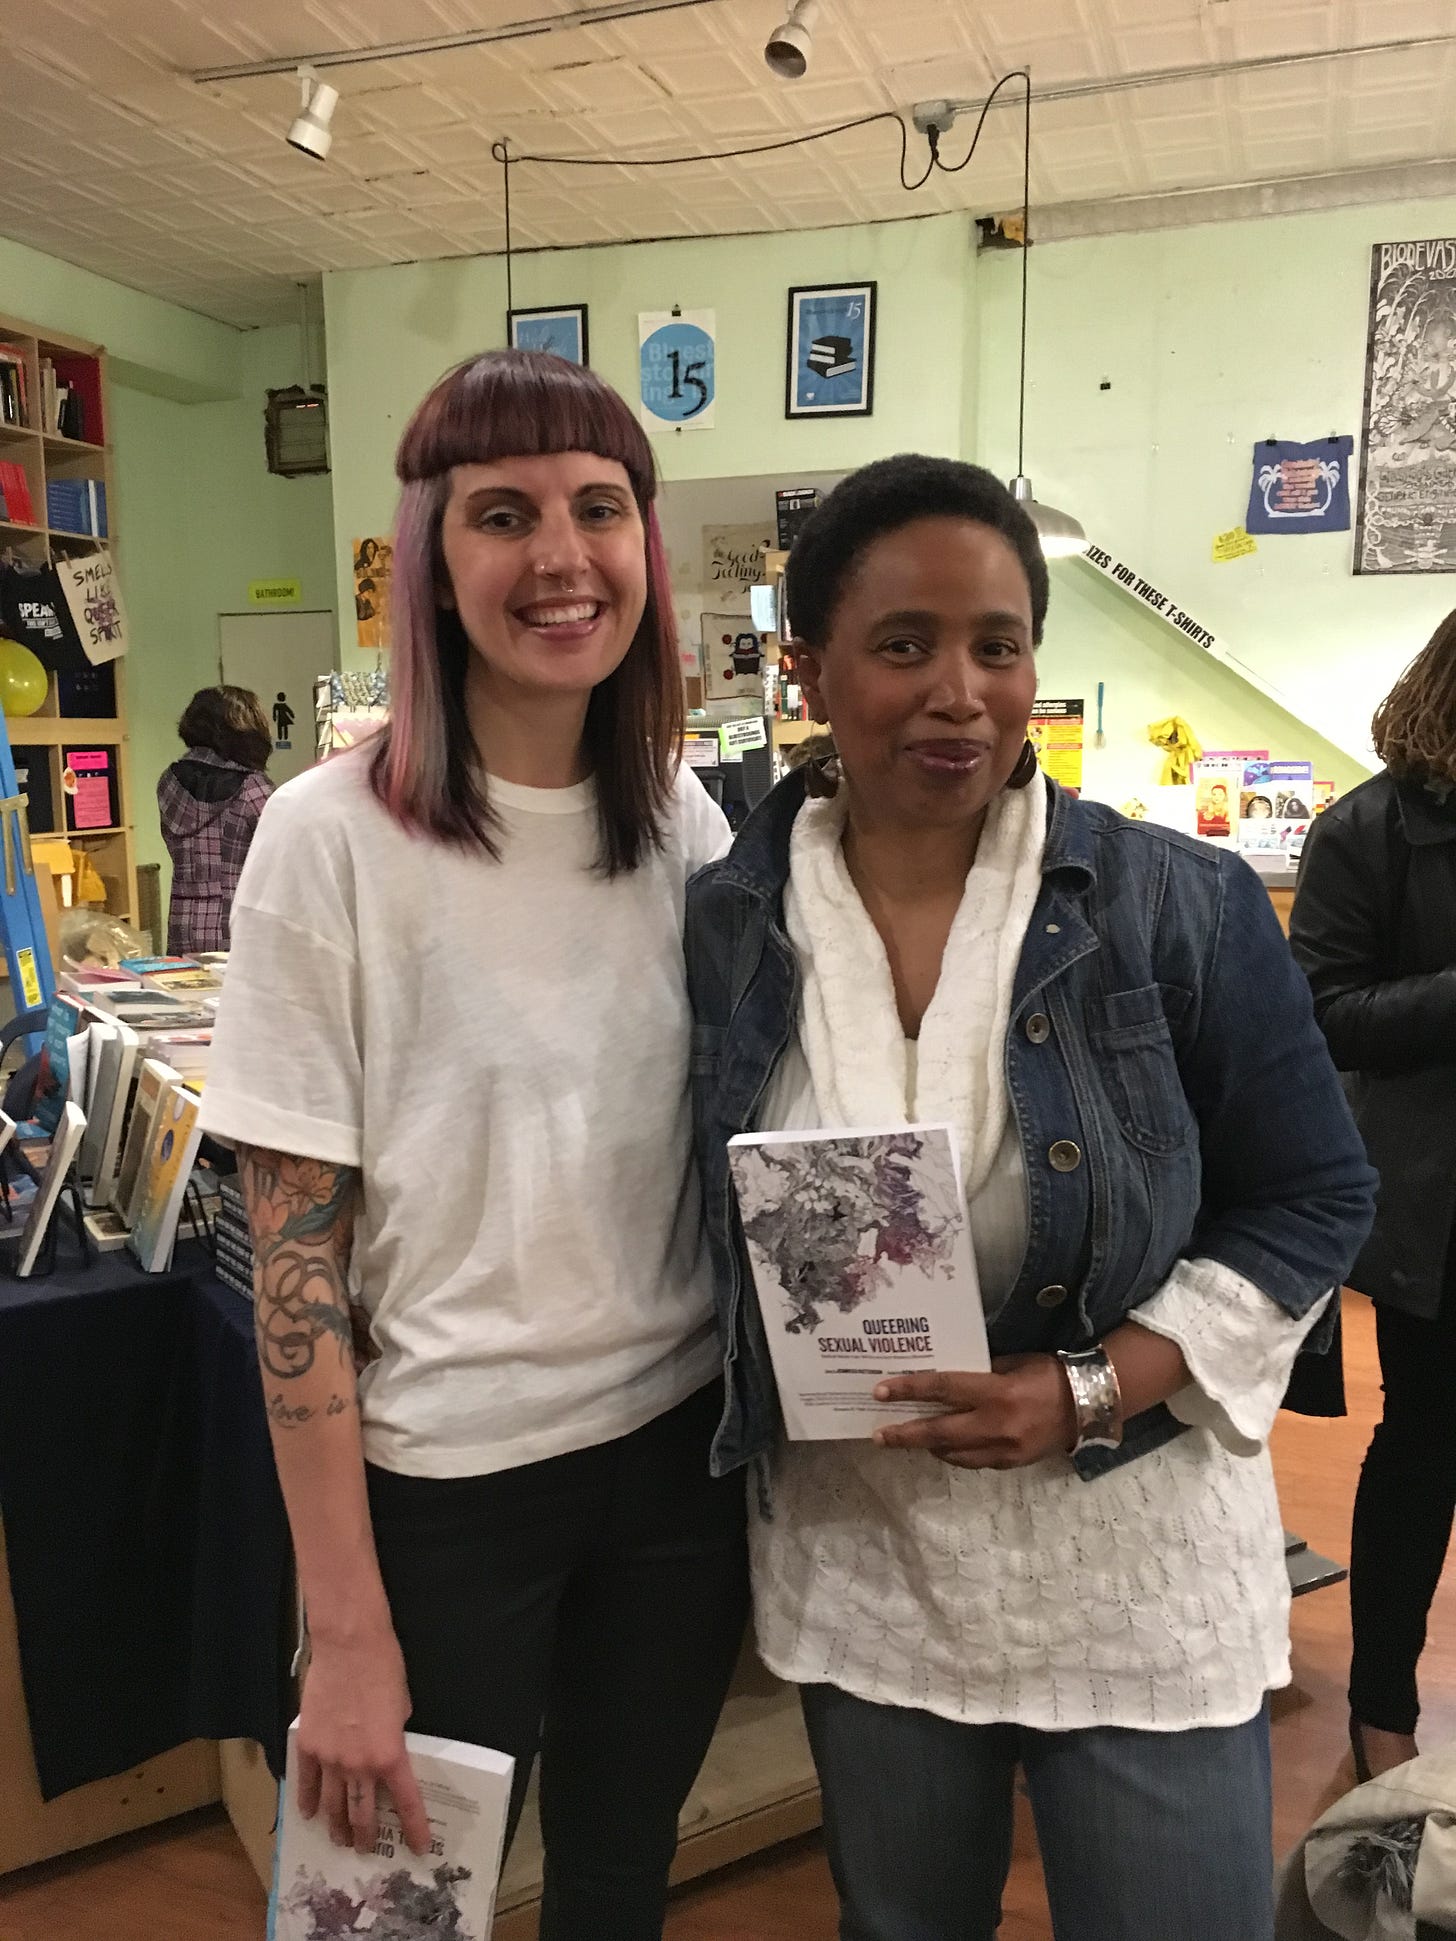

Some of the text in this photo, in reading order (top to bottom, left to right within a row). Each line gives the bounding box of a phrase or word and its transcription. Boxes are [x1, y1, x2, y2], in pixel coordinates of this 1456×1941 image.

[846, 301, 862, 320] 15
[667, 350, 707, 416] 15
[1083, 545, 1215, 648] IZES FOR THESE T-SHIRTS
[863, 1317, 929, 1334] QUEERING
[818, 1336, 933, 1353] SEXUAL VIOLENCE
